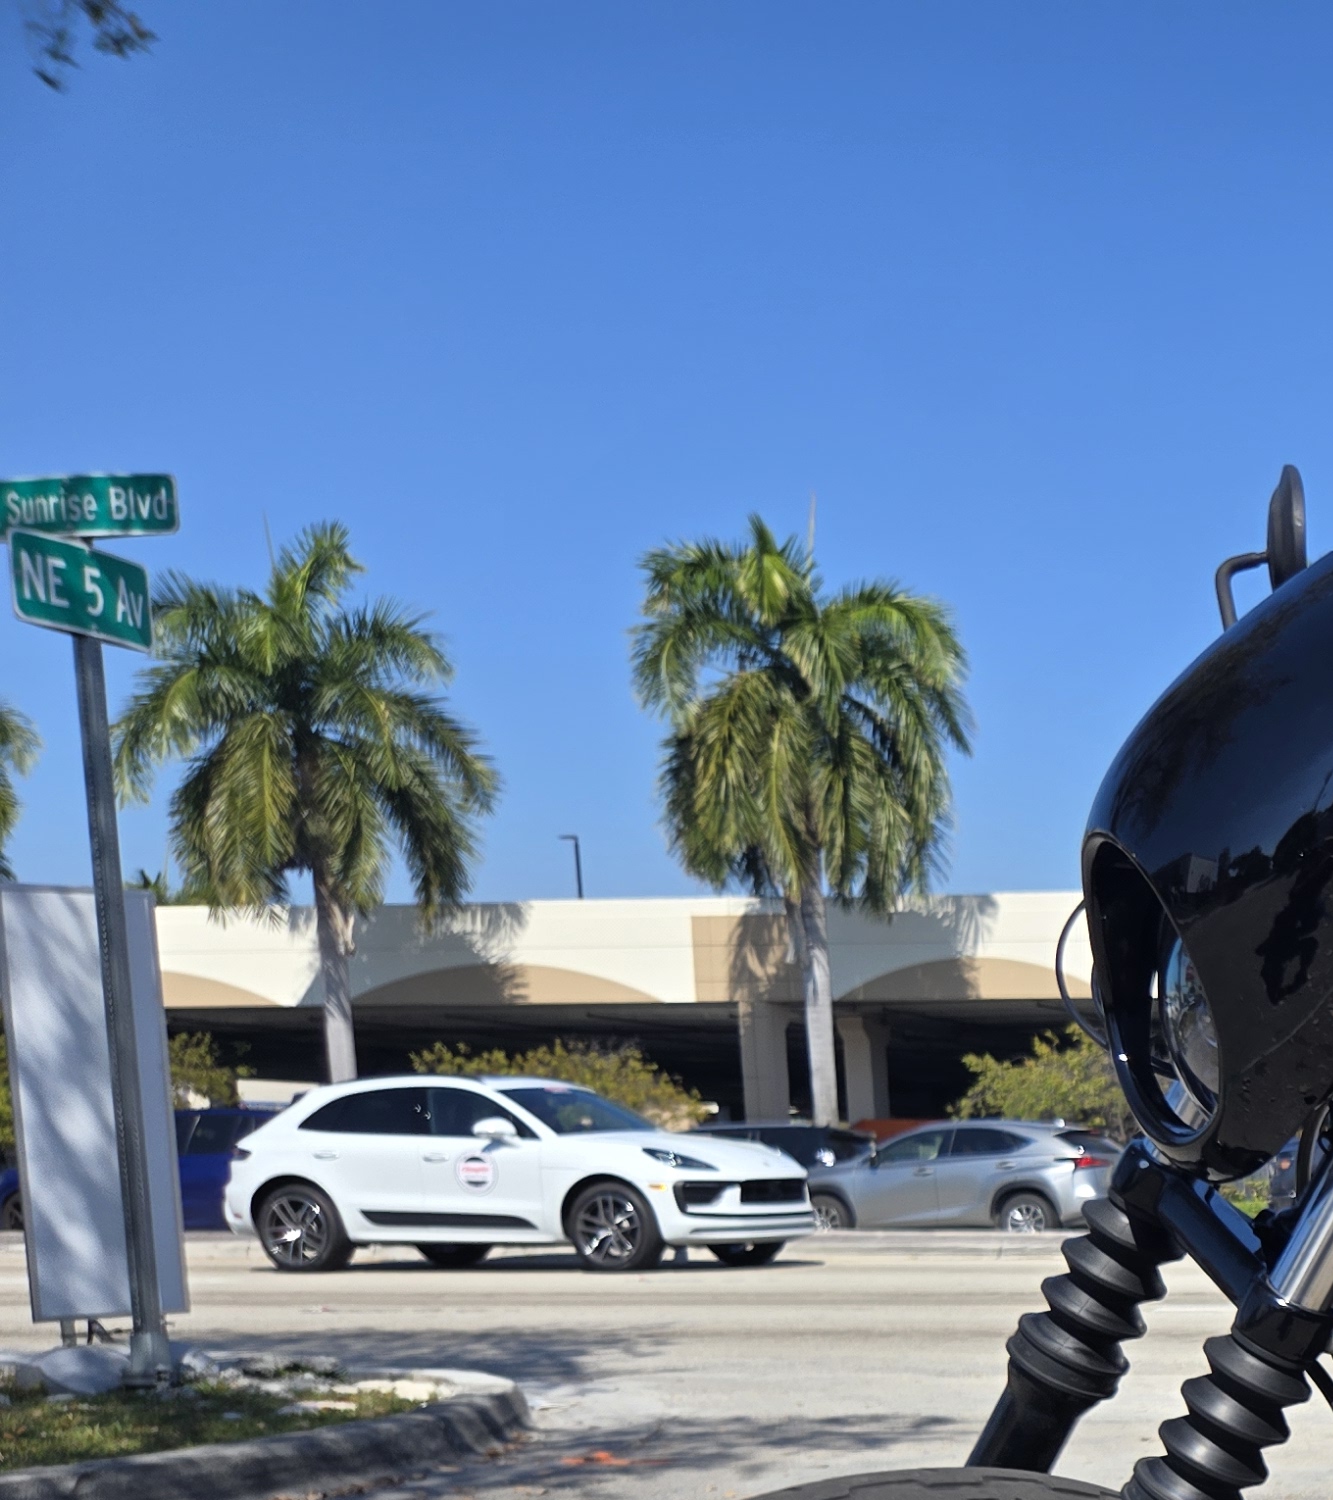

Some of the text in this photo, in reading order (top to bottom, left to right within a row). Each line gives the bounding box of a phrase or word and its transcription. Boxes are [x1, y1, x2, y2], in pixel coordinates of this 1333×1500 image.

[6, 485, 169, 526] Sunrise Blvd
[19, 548, 70, 609] NE
[83, 565, 105, 618] 5
